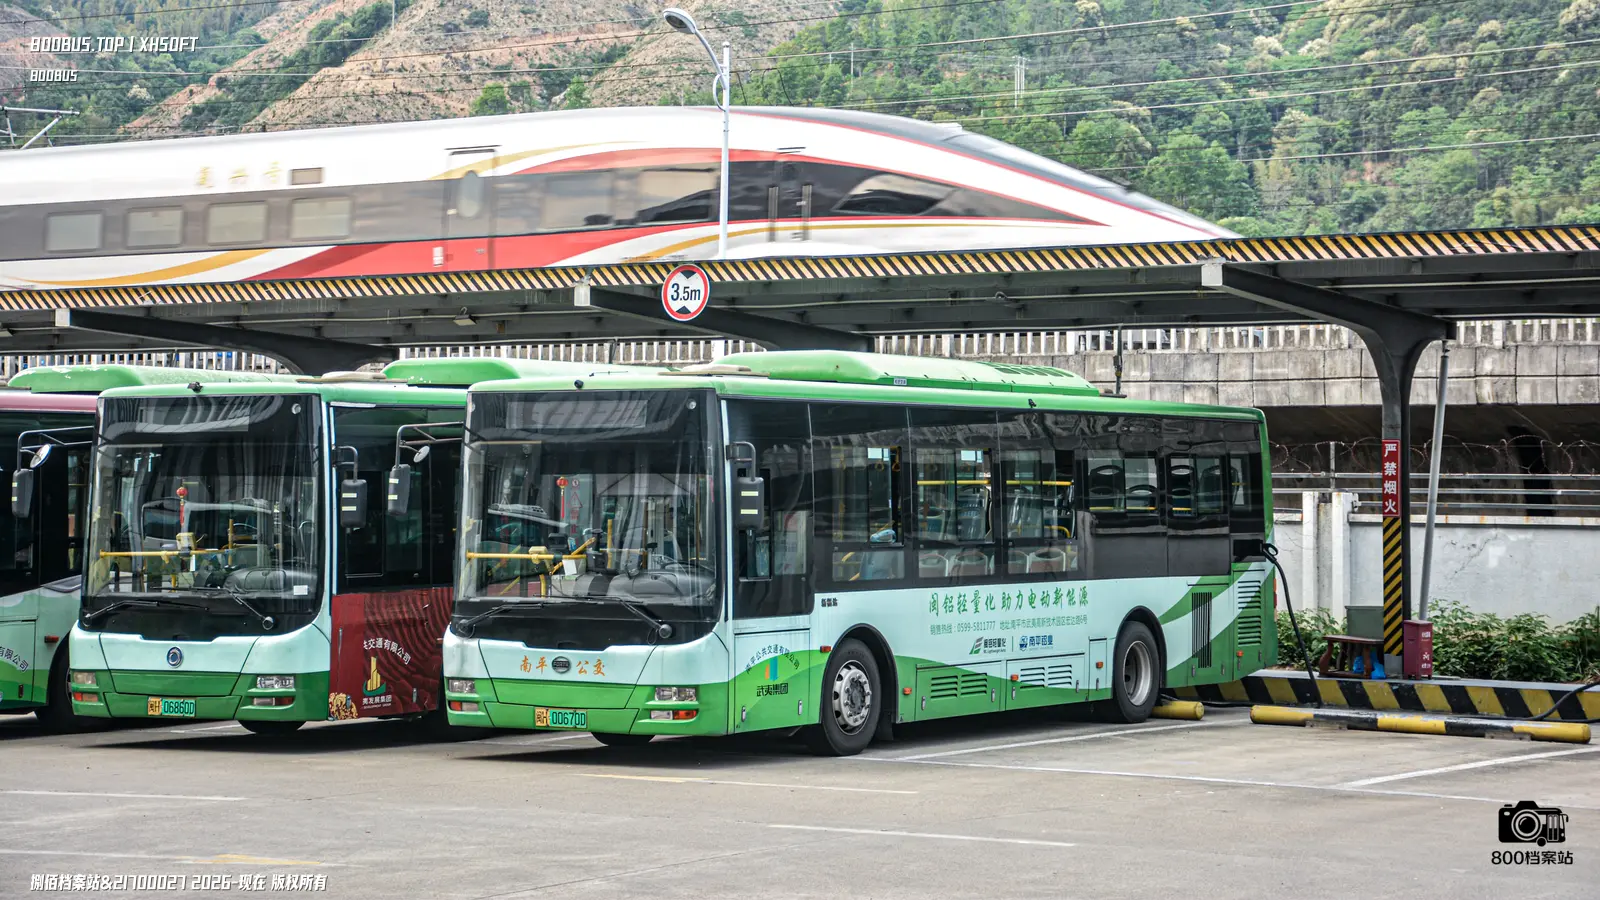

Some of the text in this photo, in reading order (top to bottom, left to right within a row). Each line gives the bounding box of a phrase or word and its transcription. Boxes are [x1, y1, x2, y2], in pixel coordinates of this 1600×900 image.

[670, 282, 701, 301] 3.5m
[1383, 443, 1397, 513] 严禁烟火
[1001, 586, 1089, 612] 助力电动新能源
[520, 655, 606, 677] 南平 公交
[756, 683, 789, 697] 武夷集团
